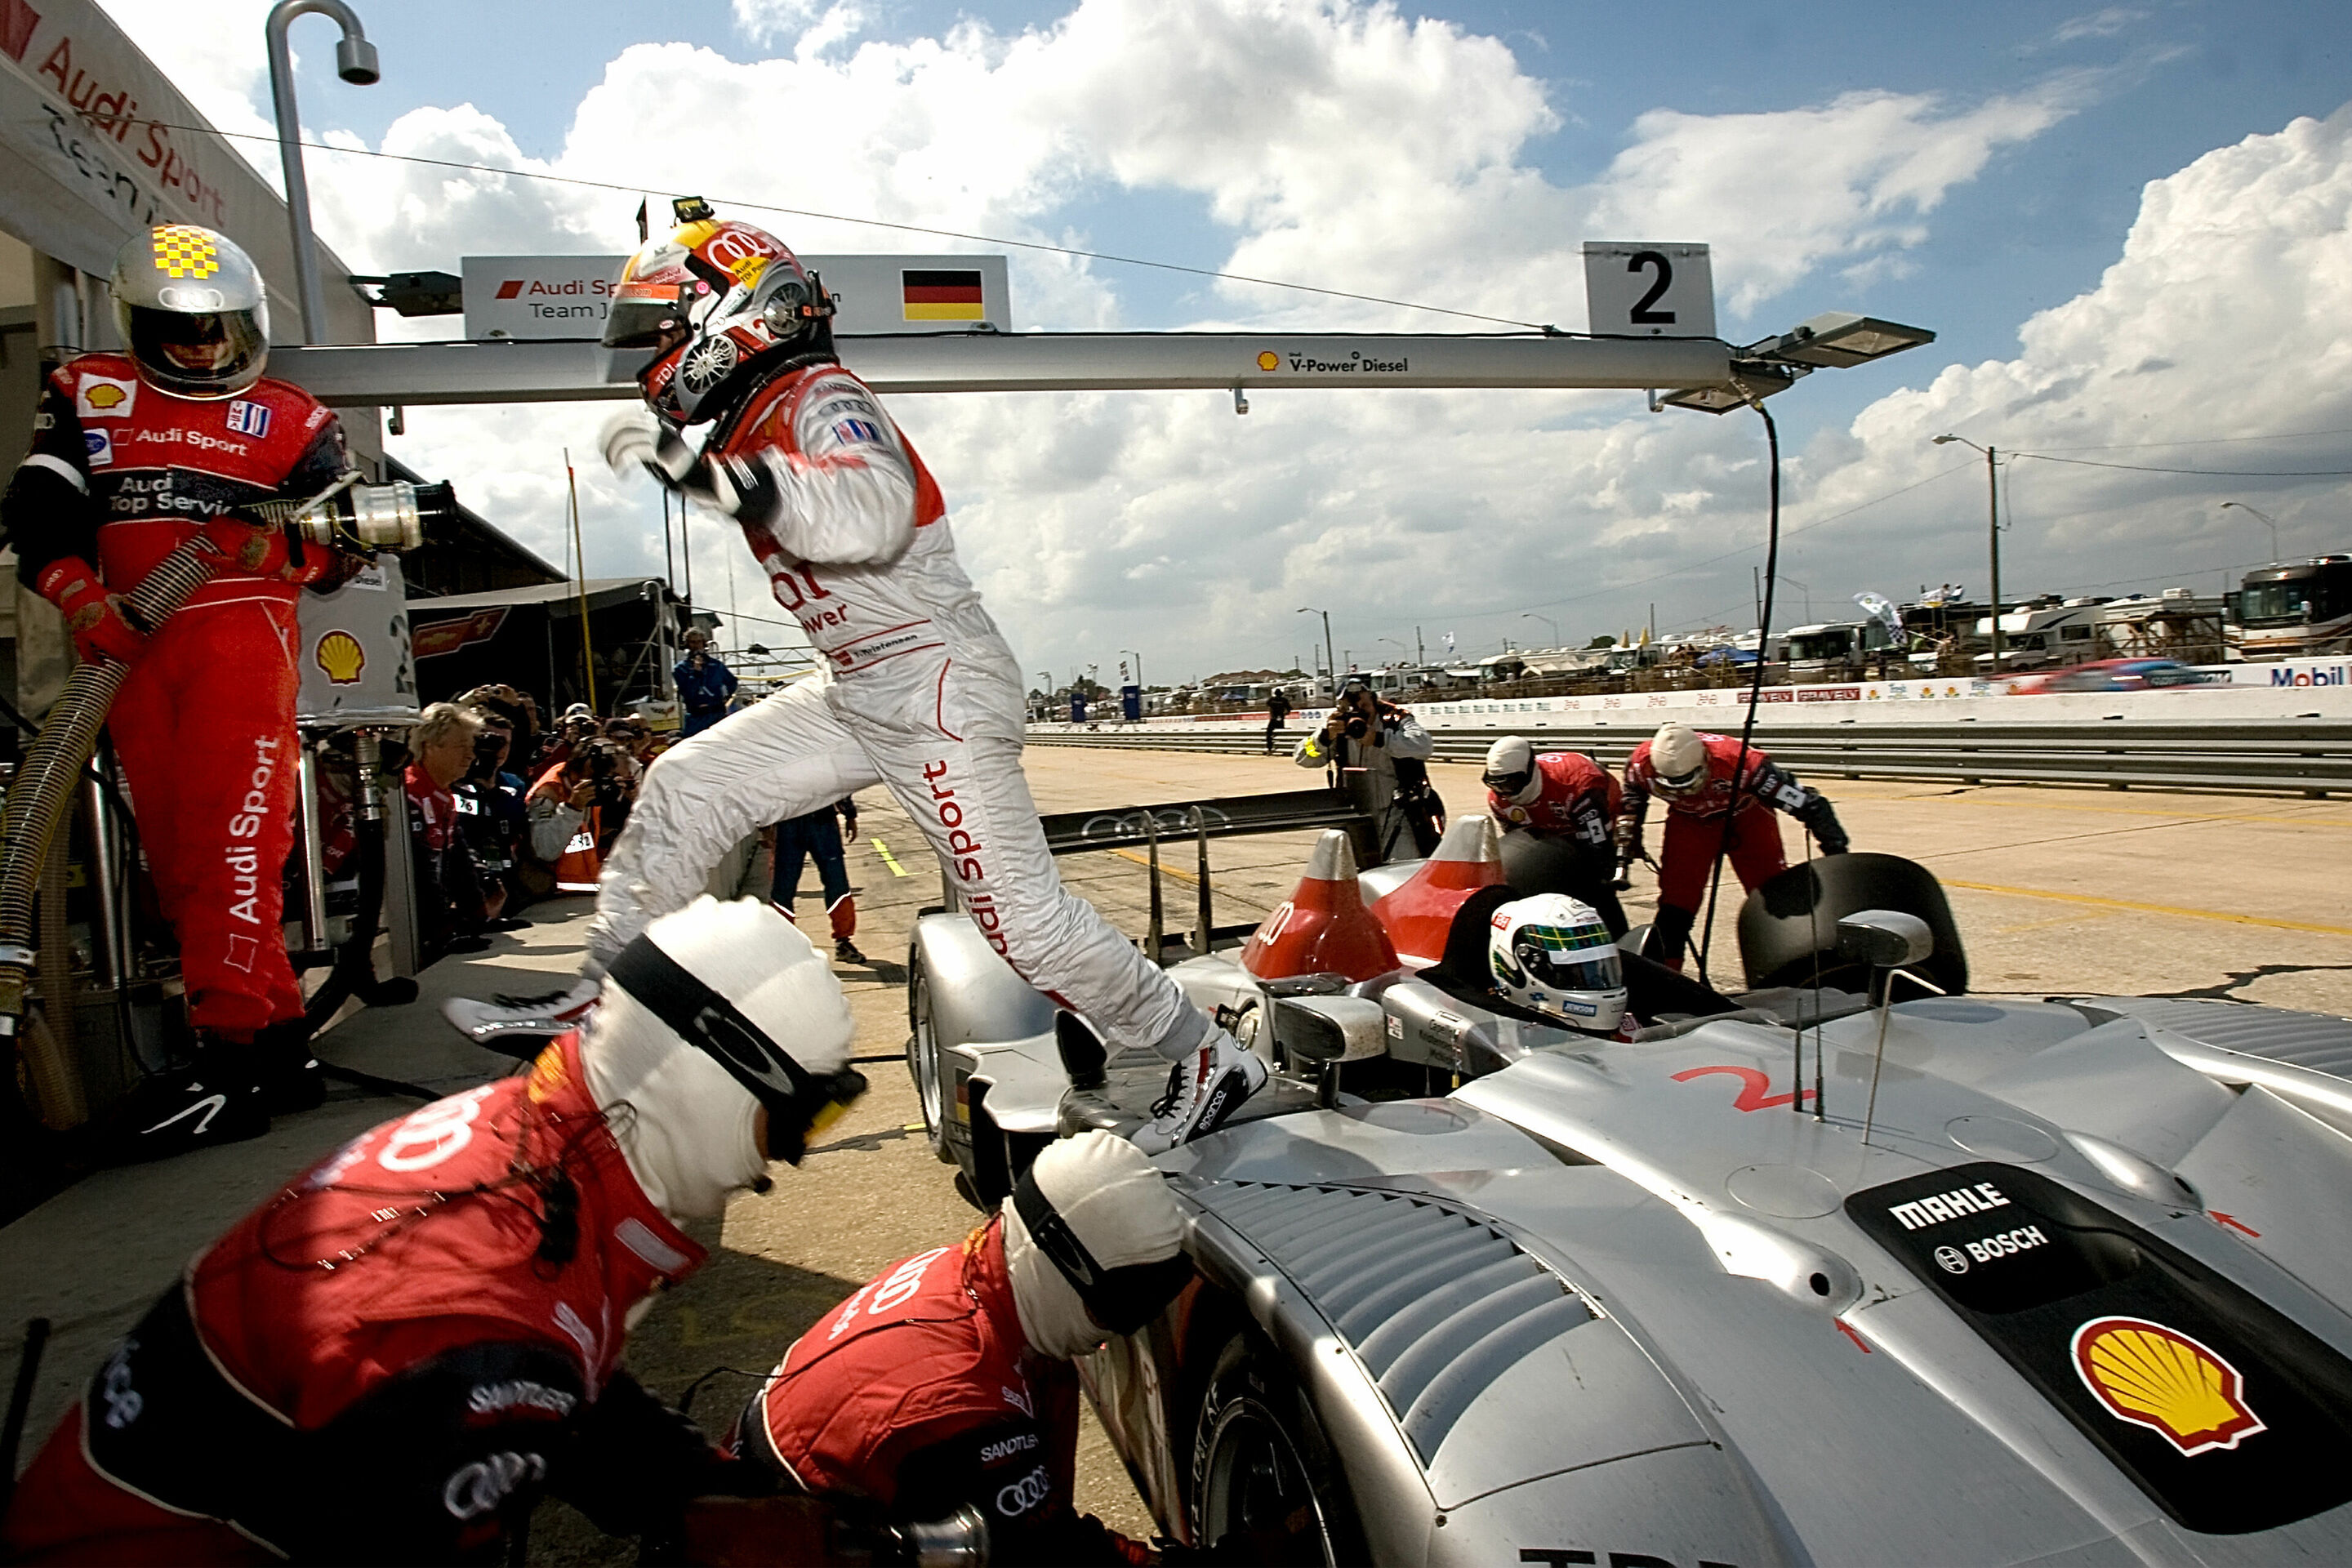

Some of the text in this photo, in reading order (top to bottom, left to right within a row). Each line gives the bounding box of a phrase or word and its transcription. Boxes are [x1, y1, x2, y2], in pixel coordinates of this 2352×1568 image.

[38, 36, 225, 229] Audi Sport
[528, 279, 585, 296] Audi
[1625, 250, 1676, 324] 2
[528, 303, 594, 318] Team
[654, 363, 677, 386] TDI
[1289, 357, 1408, 372] V-Power Diesel
[136, 428, 248, 456] Audi Sport
[118, 471, 175, 493] Audi
[109, 492, 232, 516] Top Servi
[801, 603, 849, 635] wer
[2271, 666, 2343, 687] Mobil
[225, 735, 281, 924] Audi Sport
[1591, 825, 1601, 836] 2
[923, 760, 1013, 963] udi Sport
[1669, 1065, 1818, 1112] 2
[1887, 1182, 2011, 1231] MAHLE
[1964, 1225, 2050, 1263] BOSCH
